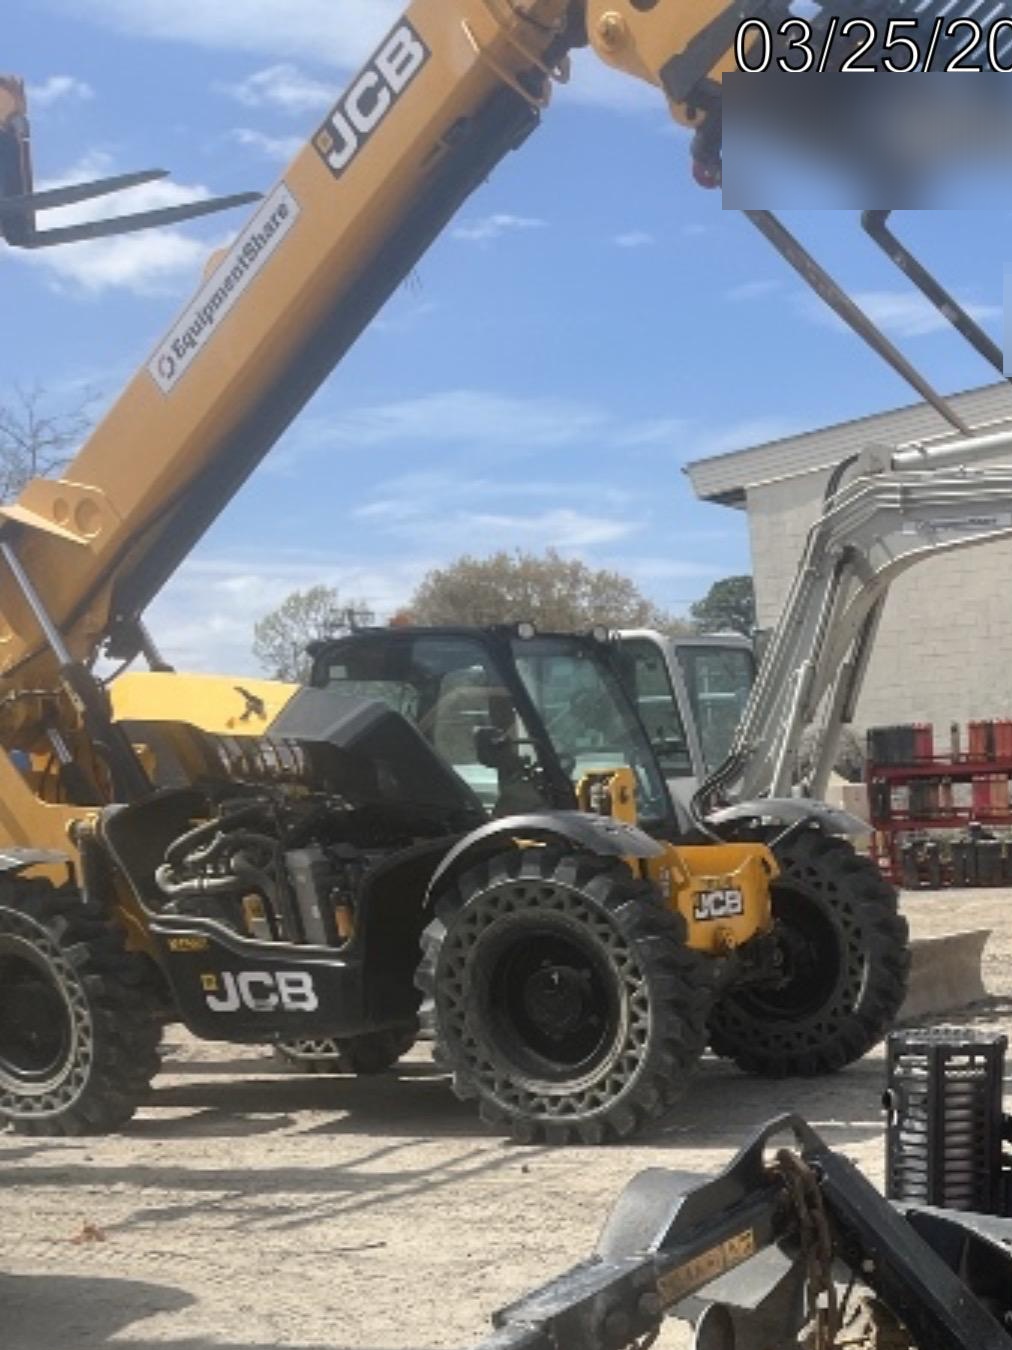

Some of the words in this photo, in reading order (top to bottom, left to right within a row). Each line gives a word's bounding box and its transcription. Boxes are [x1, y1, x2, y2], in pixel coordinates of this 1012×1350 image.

[328, 26, 424, 169] JCB
[171, 203, 289, 358] EquipmentShare
[695, 890, 741, 918] JCB
[205, 971, 318, 1012] JCB
